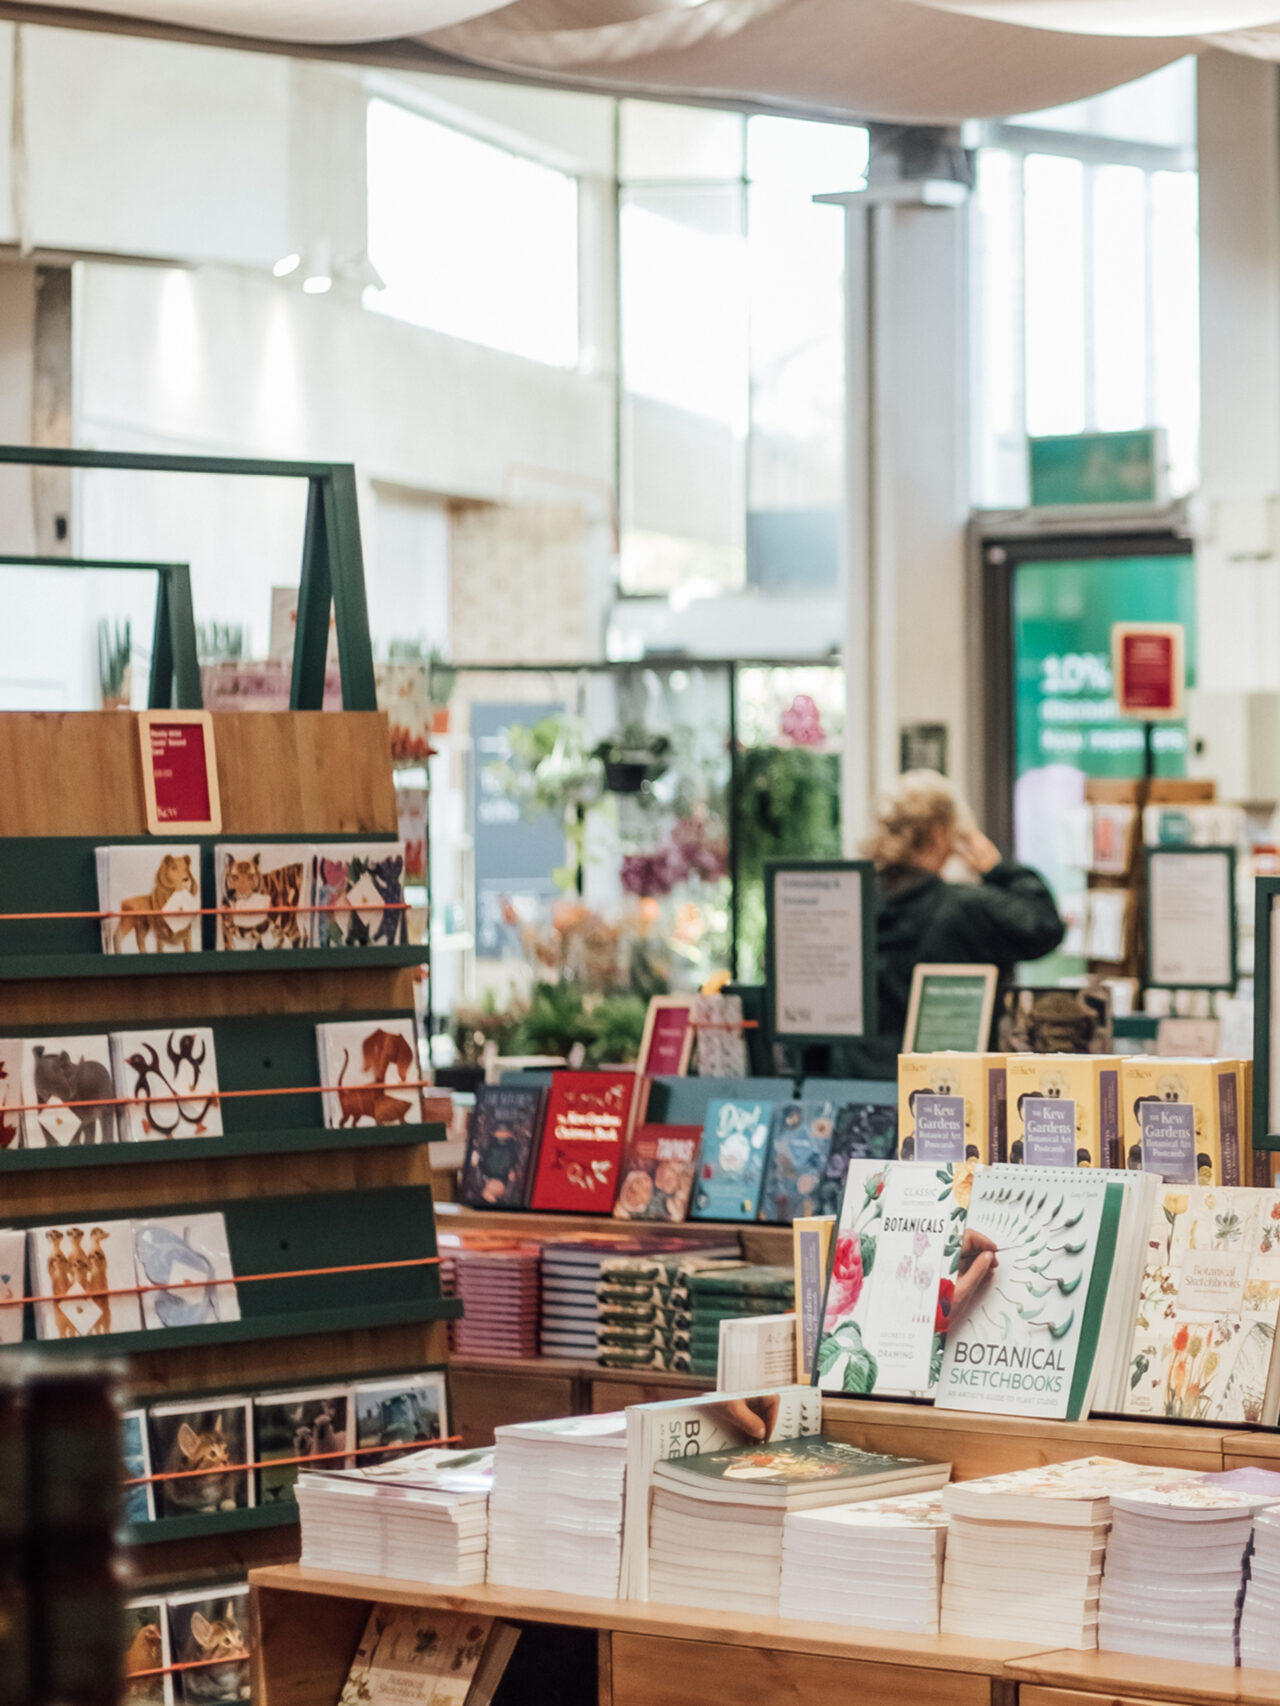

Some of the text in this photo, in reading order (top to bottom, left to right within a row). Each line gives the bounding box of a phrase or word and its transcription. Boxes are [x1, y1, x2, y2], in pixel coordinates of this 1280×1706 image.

[1043, 653, 1112, 693] 10%
[934, 1103, 955, 1116] Kew
[1043, 1107, 1065, 1119] Kew
[918, 1117, 961, 1130] Gardens
[1161, 1111, 1185, 1124] Kew
[1027, 1120, 1072, 1133] Gardens
[1145, 1125, 1191, 1138] Gardens
[884, 1217, 945, 1233] BOTANICALS
[953, 1341, 1065, 1371] BOTANICAL
[949, 1368, 1063, 1393] SKETCHBOOKS
